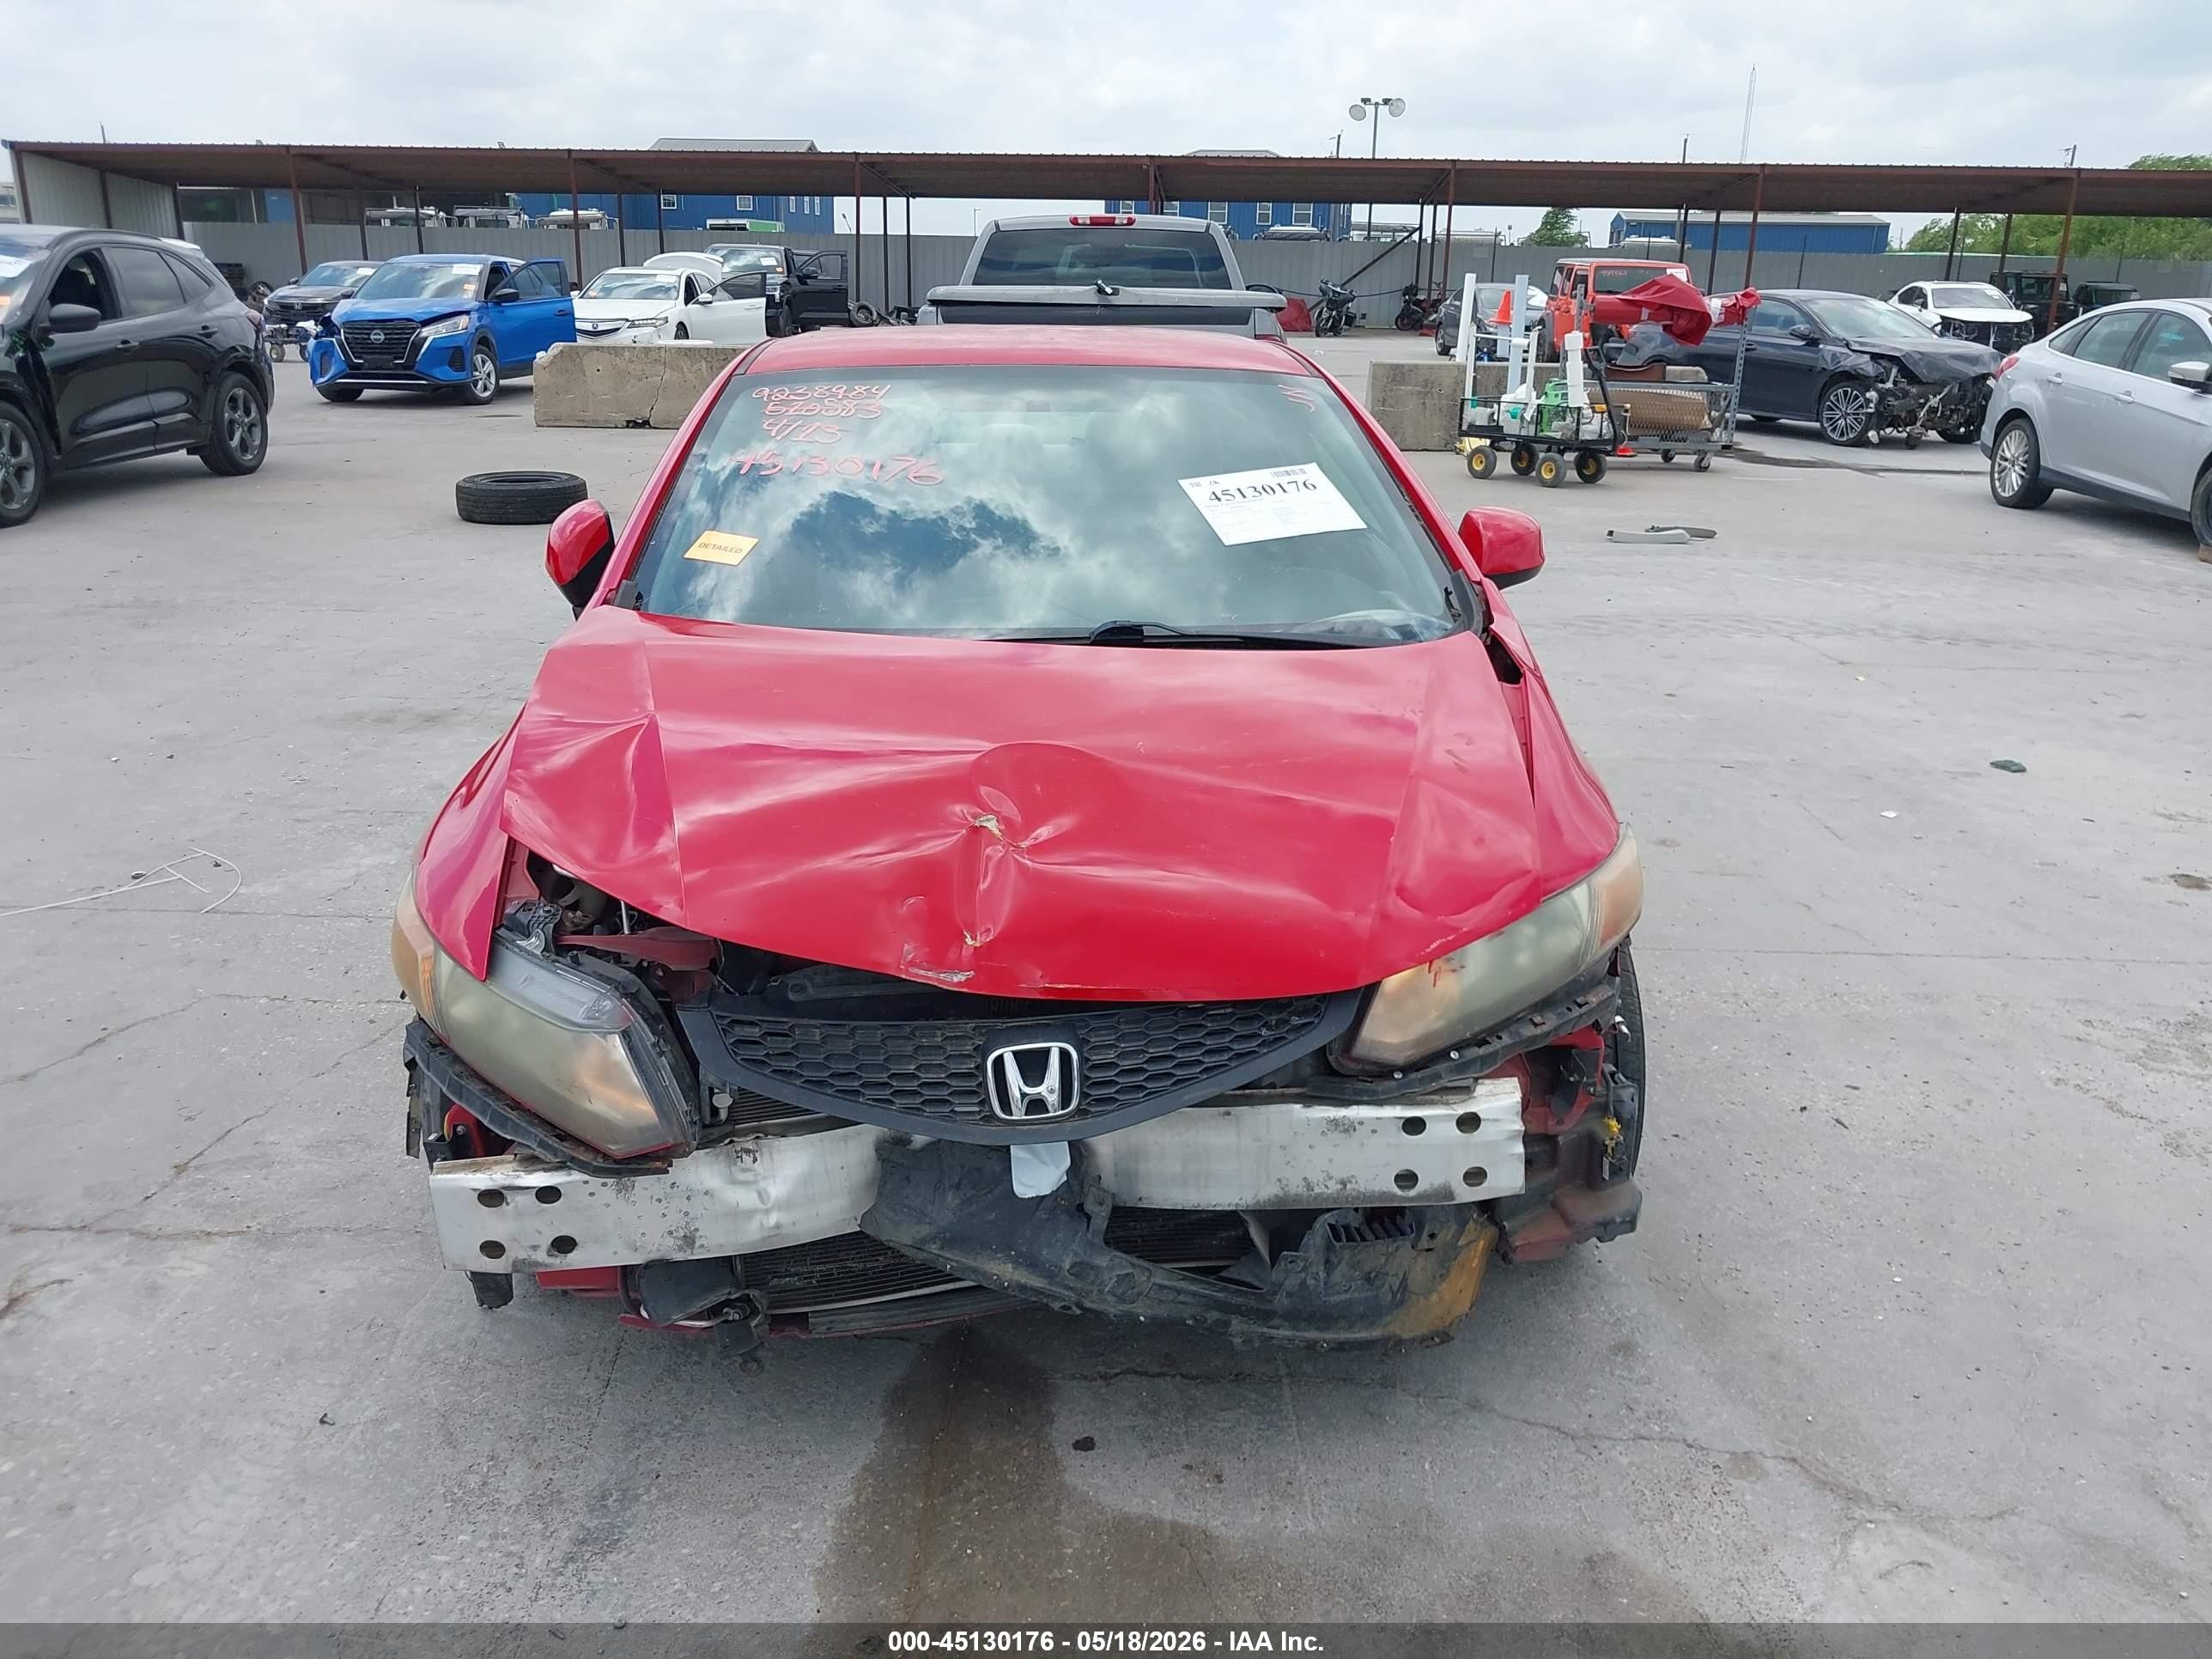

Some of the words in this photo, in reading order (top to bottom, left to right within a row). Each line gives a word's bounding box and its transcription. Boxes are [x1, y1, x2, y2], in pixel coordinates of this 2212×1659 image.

[751, 384, 892, 401] 9238984
[730, 451, 944, 486] 45130176
[1208, 479, 1317, 502] 45130176
[697, 542, 744, 554] DETAILED
